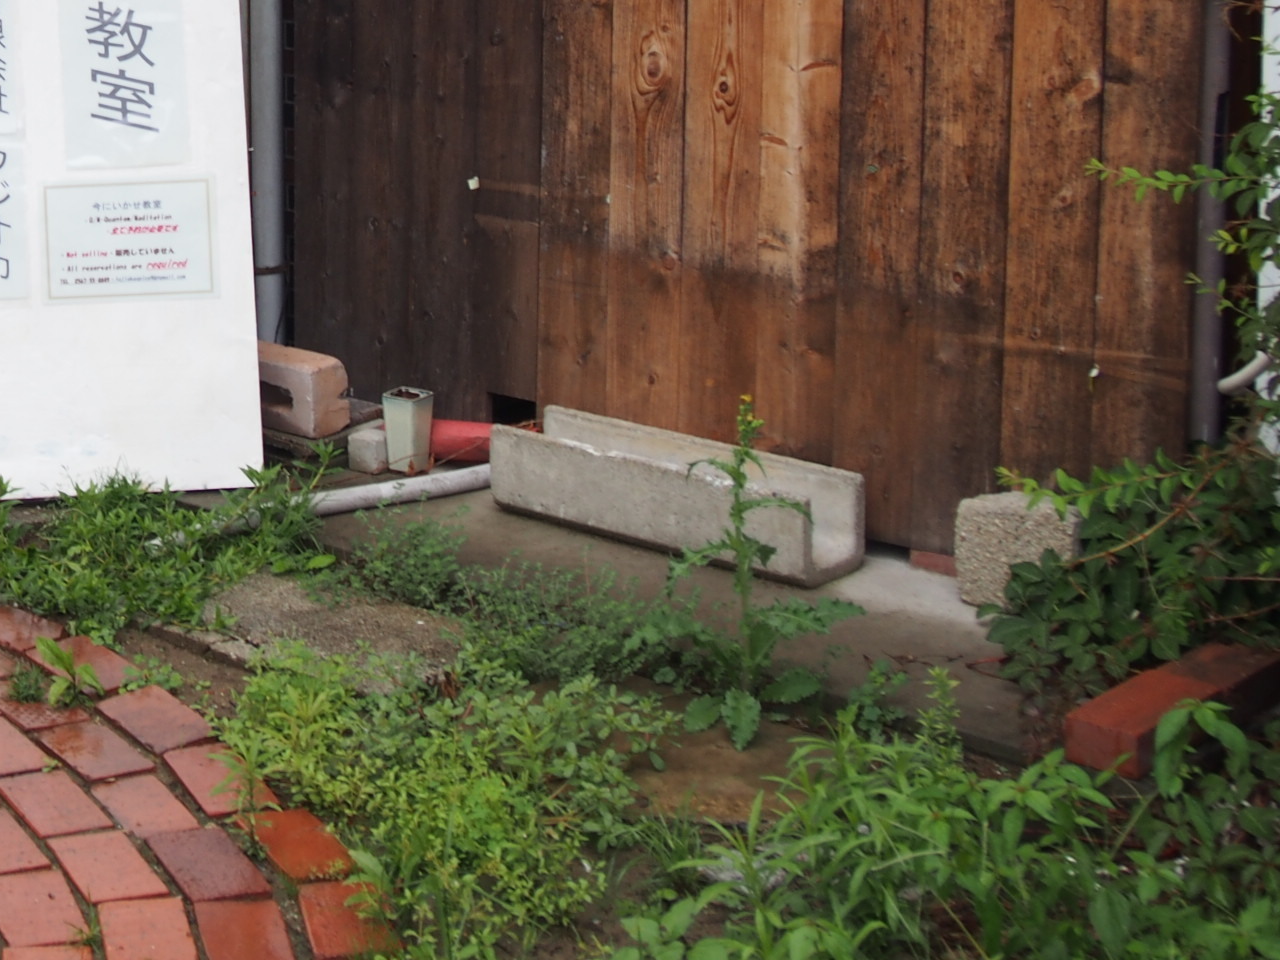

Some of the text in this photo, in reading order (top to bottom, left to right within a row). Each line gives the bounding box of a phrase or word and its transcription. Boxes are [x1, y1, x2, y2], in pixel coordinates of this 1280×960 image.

[91, 199, 163, 212] 今にいかせ教室
